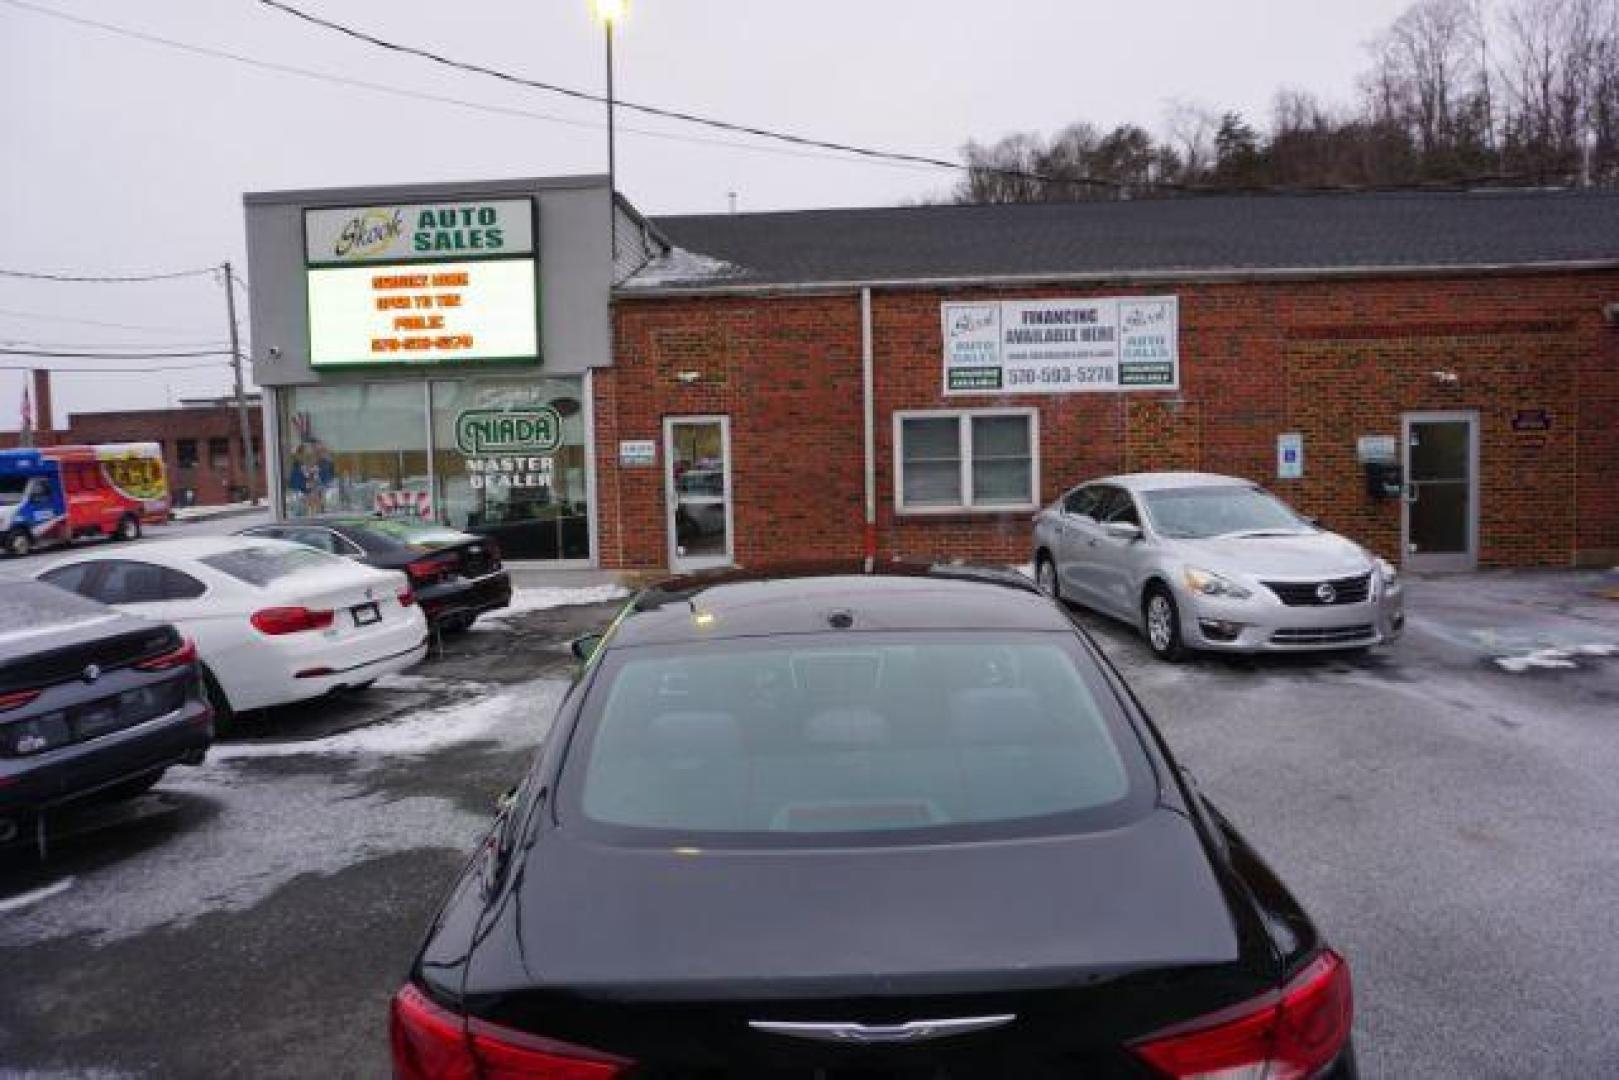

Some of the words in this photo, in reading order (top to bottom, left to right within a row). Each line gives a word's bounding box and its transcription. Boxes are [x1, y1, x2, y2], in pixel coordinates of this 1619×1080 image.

[417, 206, 498, 228] AUTO
[413, 229, 505, 251] SALES
[1021, 308, 1098, 325] FINANCING
[1006, 328, 1077, 344] AVAILABLE
[1080, 326, 1114, 342] HERE
[464, 418, 550, 444] NIADA
[465, 457, 553, 471] MASTER
[470, 474, 552, 489] DEALER
